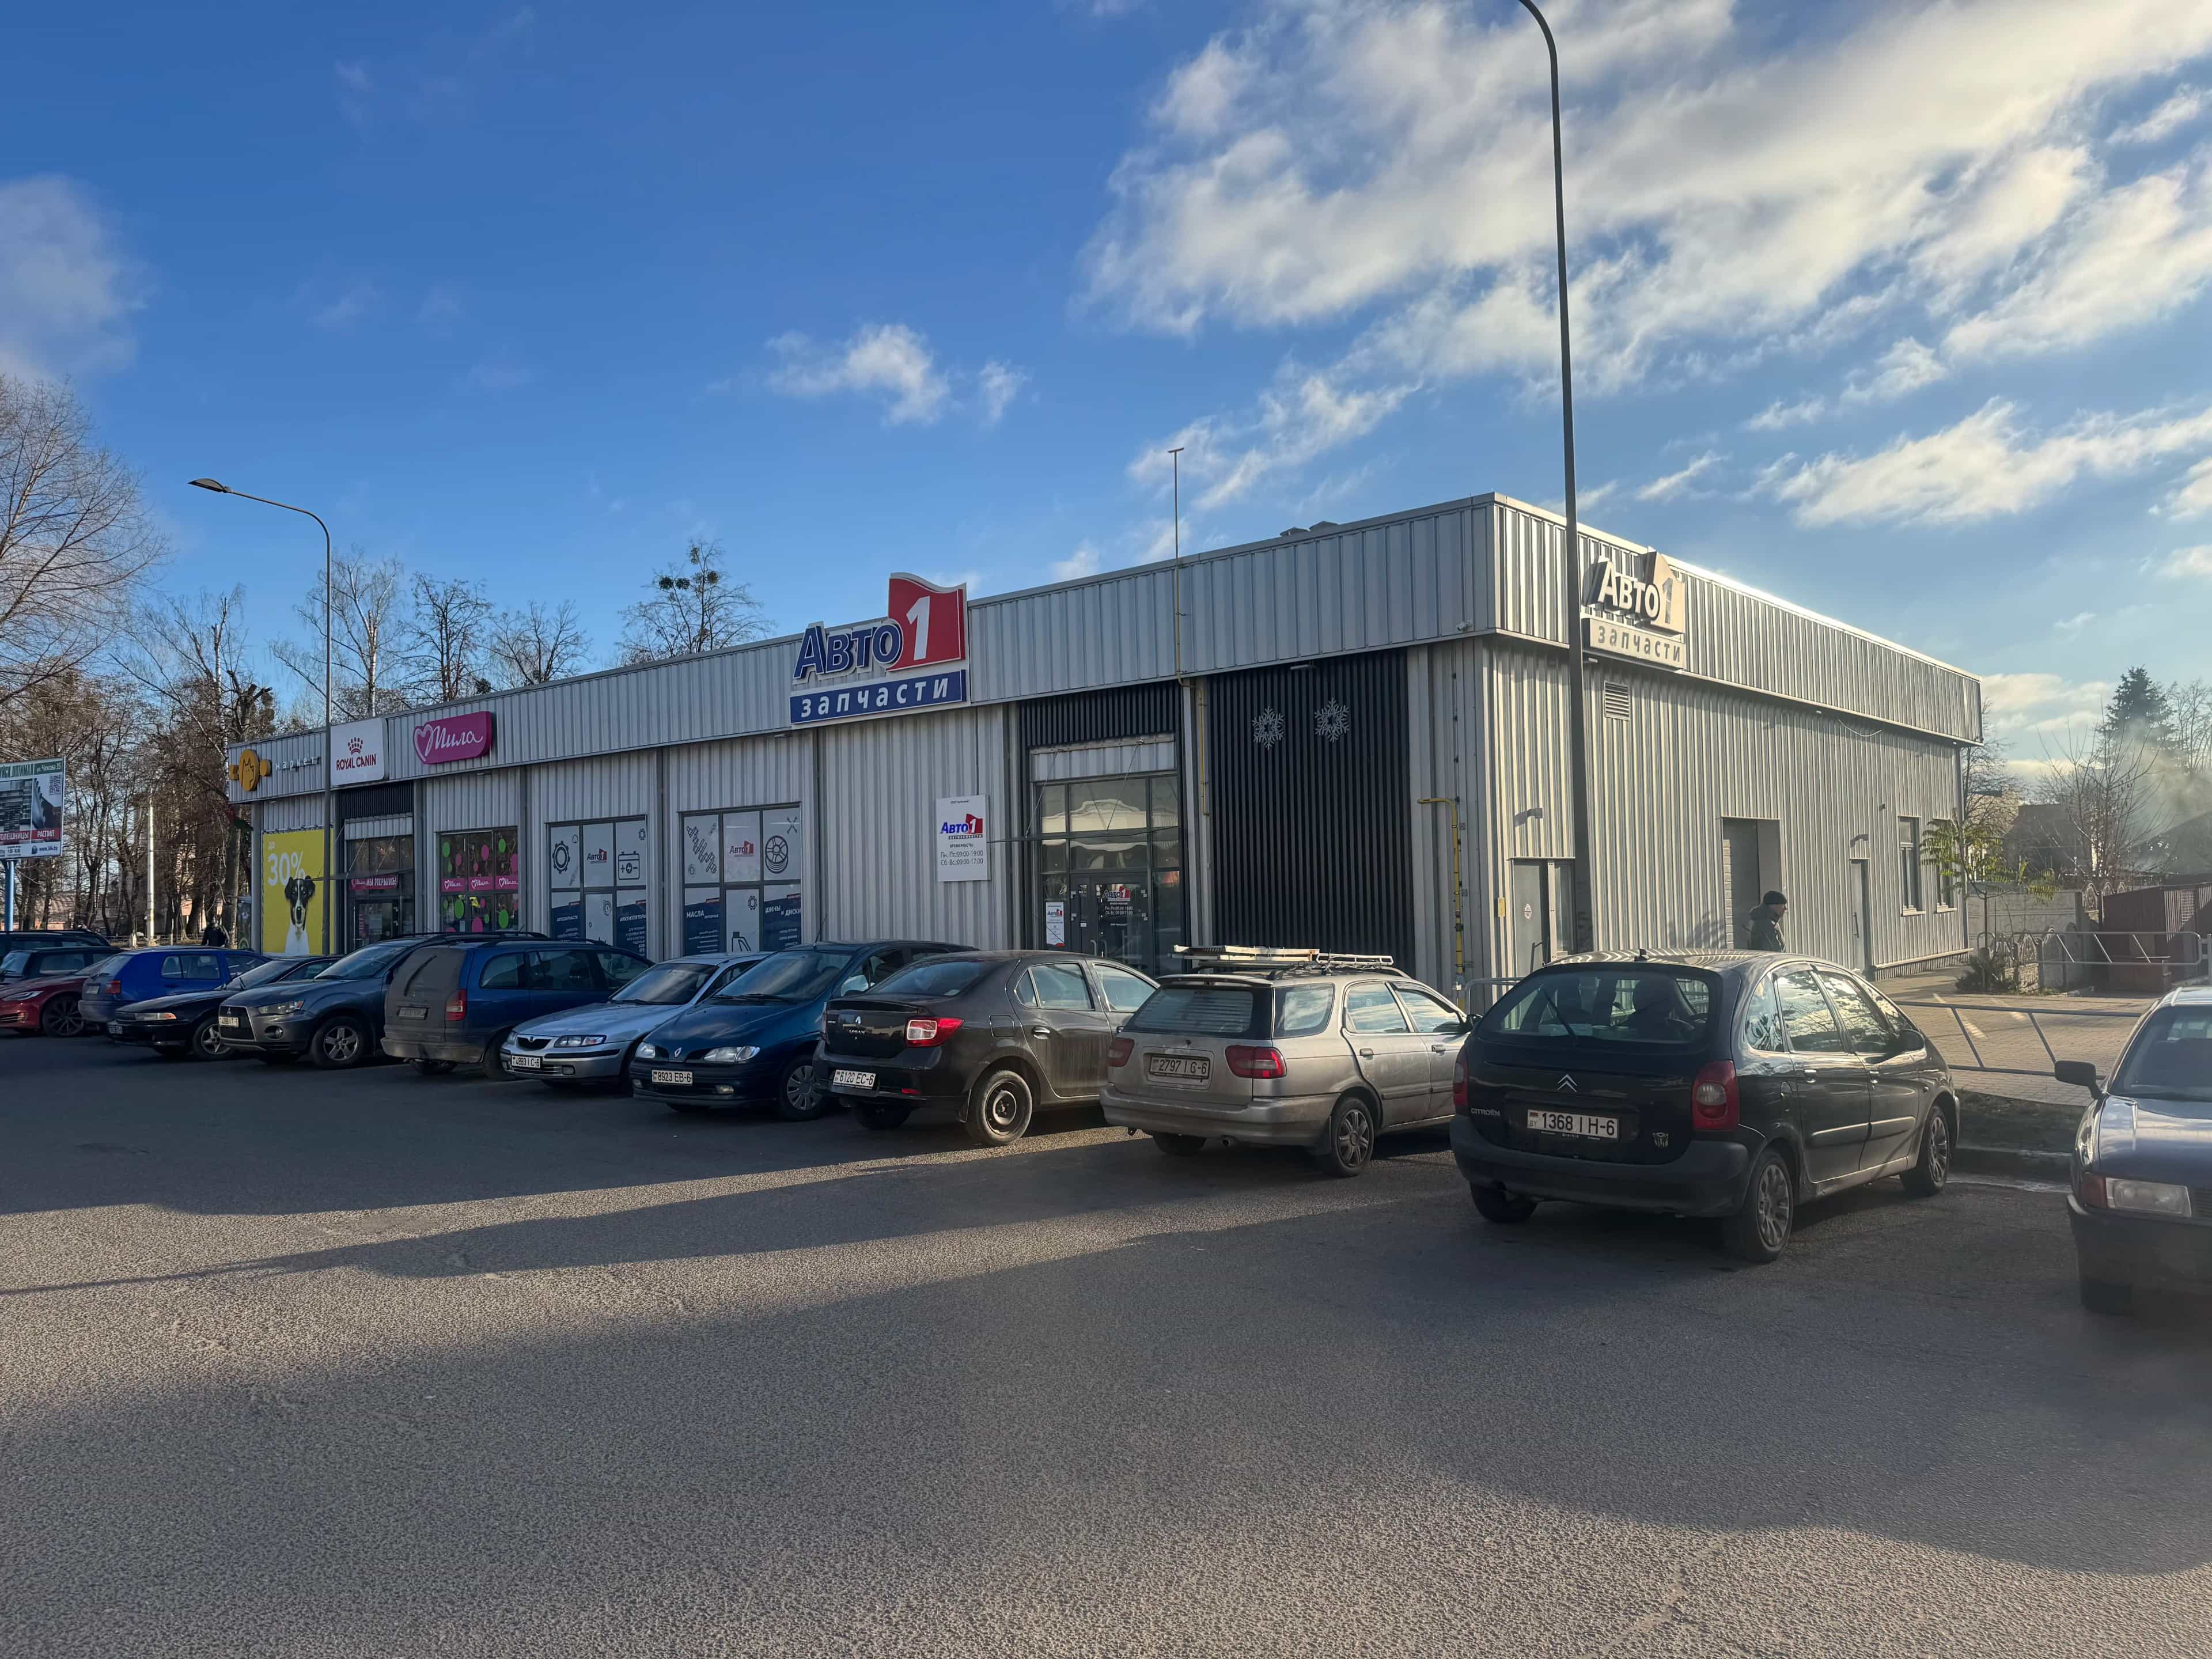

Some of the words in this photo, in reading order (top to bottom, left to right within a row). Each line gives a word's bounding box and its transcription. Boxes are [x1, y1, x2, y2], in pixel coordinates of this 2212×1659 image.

[1597, 625, 1681, 663] запчасти
[801, 677, 949, 718] запчасти
[336, 757, 355, 771] ROYAL
[357, 754, 377, 768] CANIN
[1159, 1059, 1181, 1072] 2797
[658, 1071, 673, 1081] 8923
[675, 1072, 692, 1082] EB-6
[839, 1071, 855, 1083] 6120
[855, 1073, 874, 1085] EC-6
[1542, 1113, 1573, 1131] 1368
